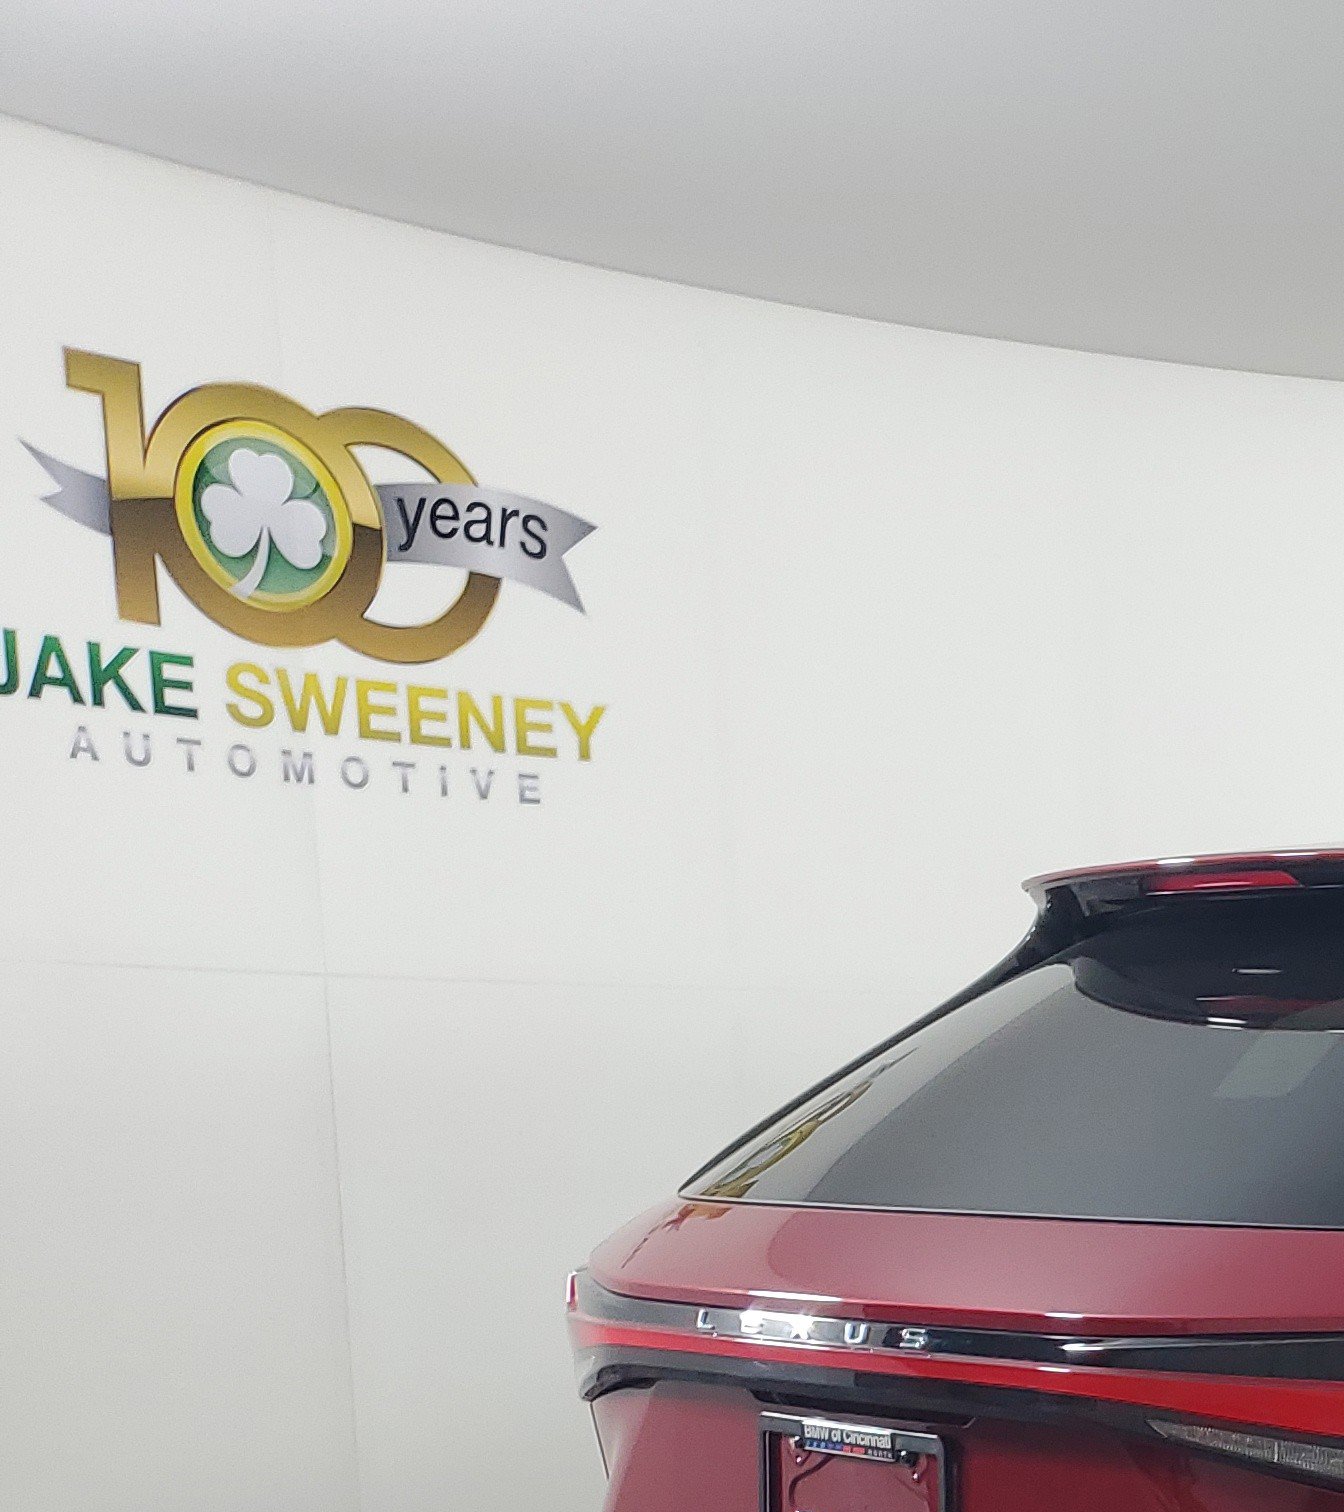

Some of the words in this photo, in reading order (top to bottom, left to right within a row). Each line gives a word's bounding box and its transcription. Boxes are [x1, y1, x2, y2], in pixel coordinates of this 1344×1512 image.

[396, 495, 549, 561] years
[0, 627, 199, 719] JAKE
[224, 661, 607, 762] SWEENEY
[68, 724, 543, 805] AUTOMOTIVE
[804, 1424, 829, 1441] BMW
[843, 1430, 891, 1450] Cincinnati
